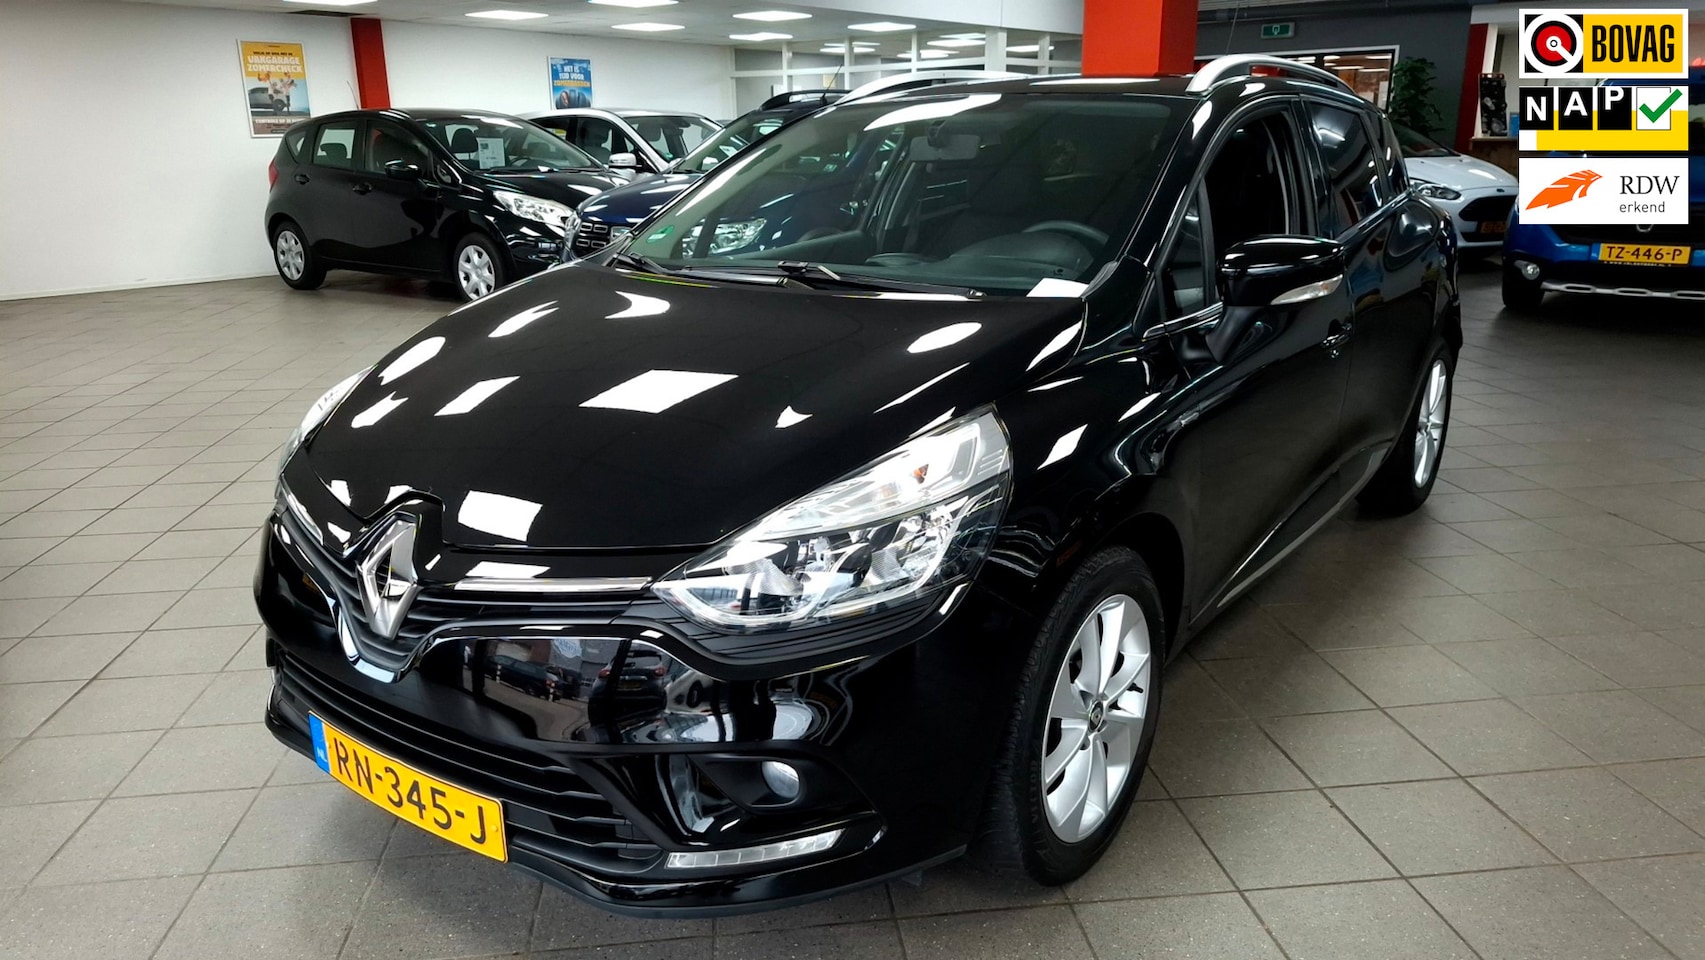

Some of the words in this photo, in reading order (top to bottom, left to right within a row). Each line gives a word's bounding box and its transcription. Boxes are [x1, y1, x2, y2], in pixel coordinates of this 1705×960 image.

[248, 56, 300, 64] VAKGARAGE
[248, 64, 302, 72] ZOMERCHECK
[1606, 245, 1683, 261] TZ-446-P
[333, 737, 487, 845] RN-345-J
